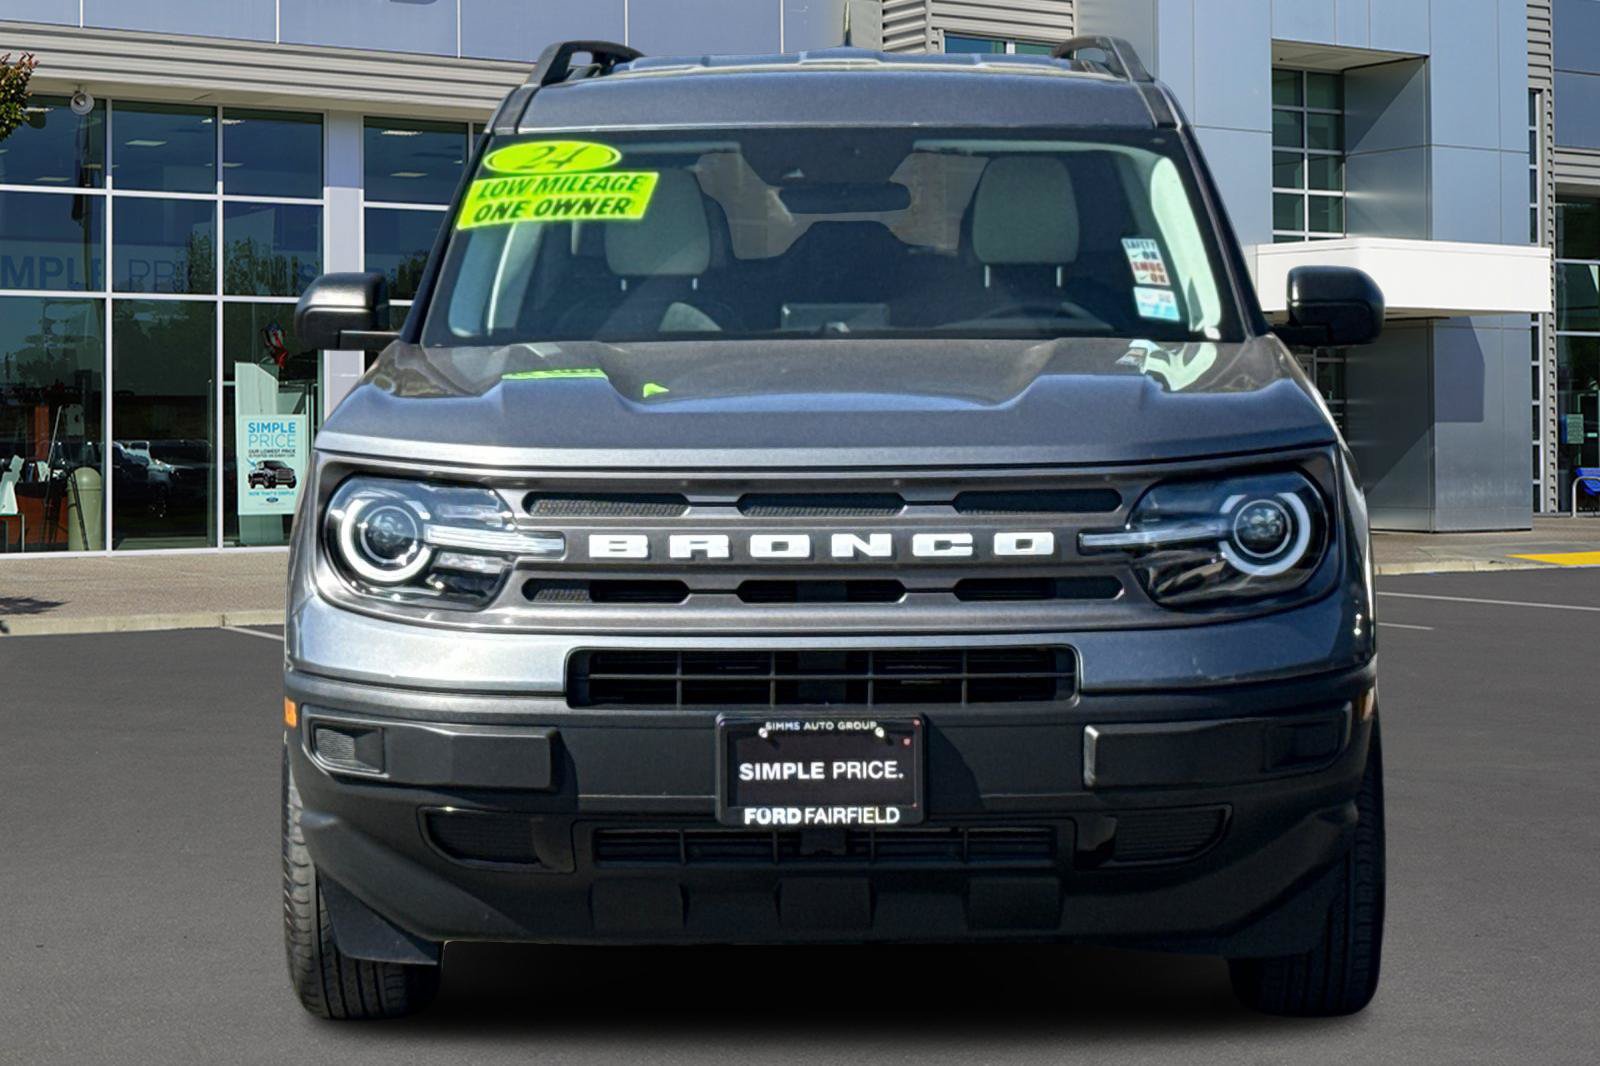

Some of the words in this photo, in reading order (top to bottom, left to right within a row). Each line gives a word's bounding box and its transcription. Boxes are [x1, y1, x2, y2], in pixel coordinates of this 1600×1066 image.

[515, 144, 590, 170] 24
[477, 178, 533, 200] LOW
[532, 174, 645, 195] MILEAGE
[473, 201, 529, 223] ONE
[533, 196, 631, 217] OWNER
[248, 422, 296, 433] SIMPLE
[248, 434, 296, 448] PRICE
[588, 531, 1055, 560] BRONCO
[764, 721, 800, 731] SIMMS
[804, 721, 835, 731] AUTO
[838, 720, 877, 731] GROUP
[739, 761, 825, 781] SIMPLE
[832, 760, 904, 780] PRICE.
[744, 807, 802, 825] FORD
[804, 806, 900, 825] FAIRFIELD
